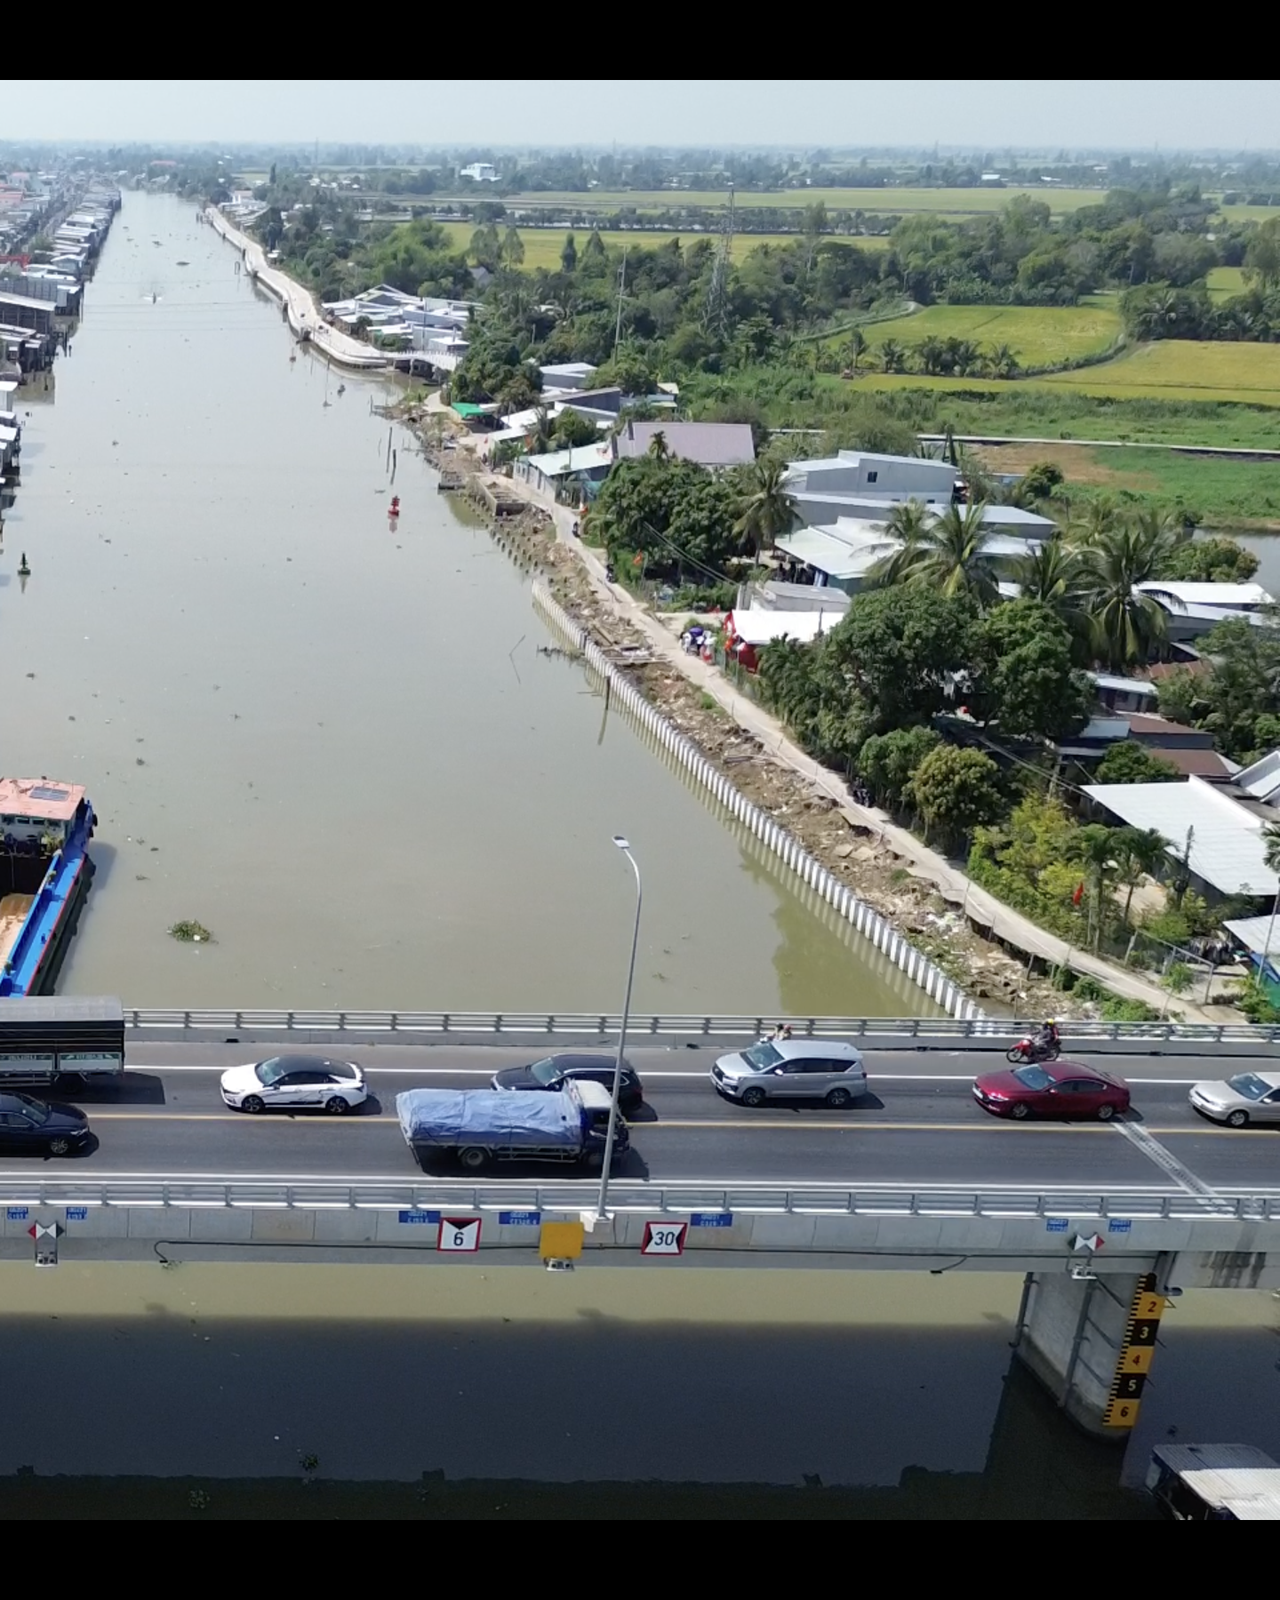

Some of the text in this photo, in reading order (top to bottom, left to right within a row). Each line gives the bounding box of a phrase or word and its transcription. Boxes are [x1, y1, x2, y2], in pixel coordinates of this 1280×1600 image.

[453, 1231, 464, 1247] 6
[654, 1231, 676, 1246] 30
[1148, 1301, 1157, 1312] 2
[1139, 1326, 1149, 1339] 3
[1132, 1354, 1141, 1365] 4
[1127, 1379, 1137, 1392] 5
[1120, 1406, 1129, 1417] 6
